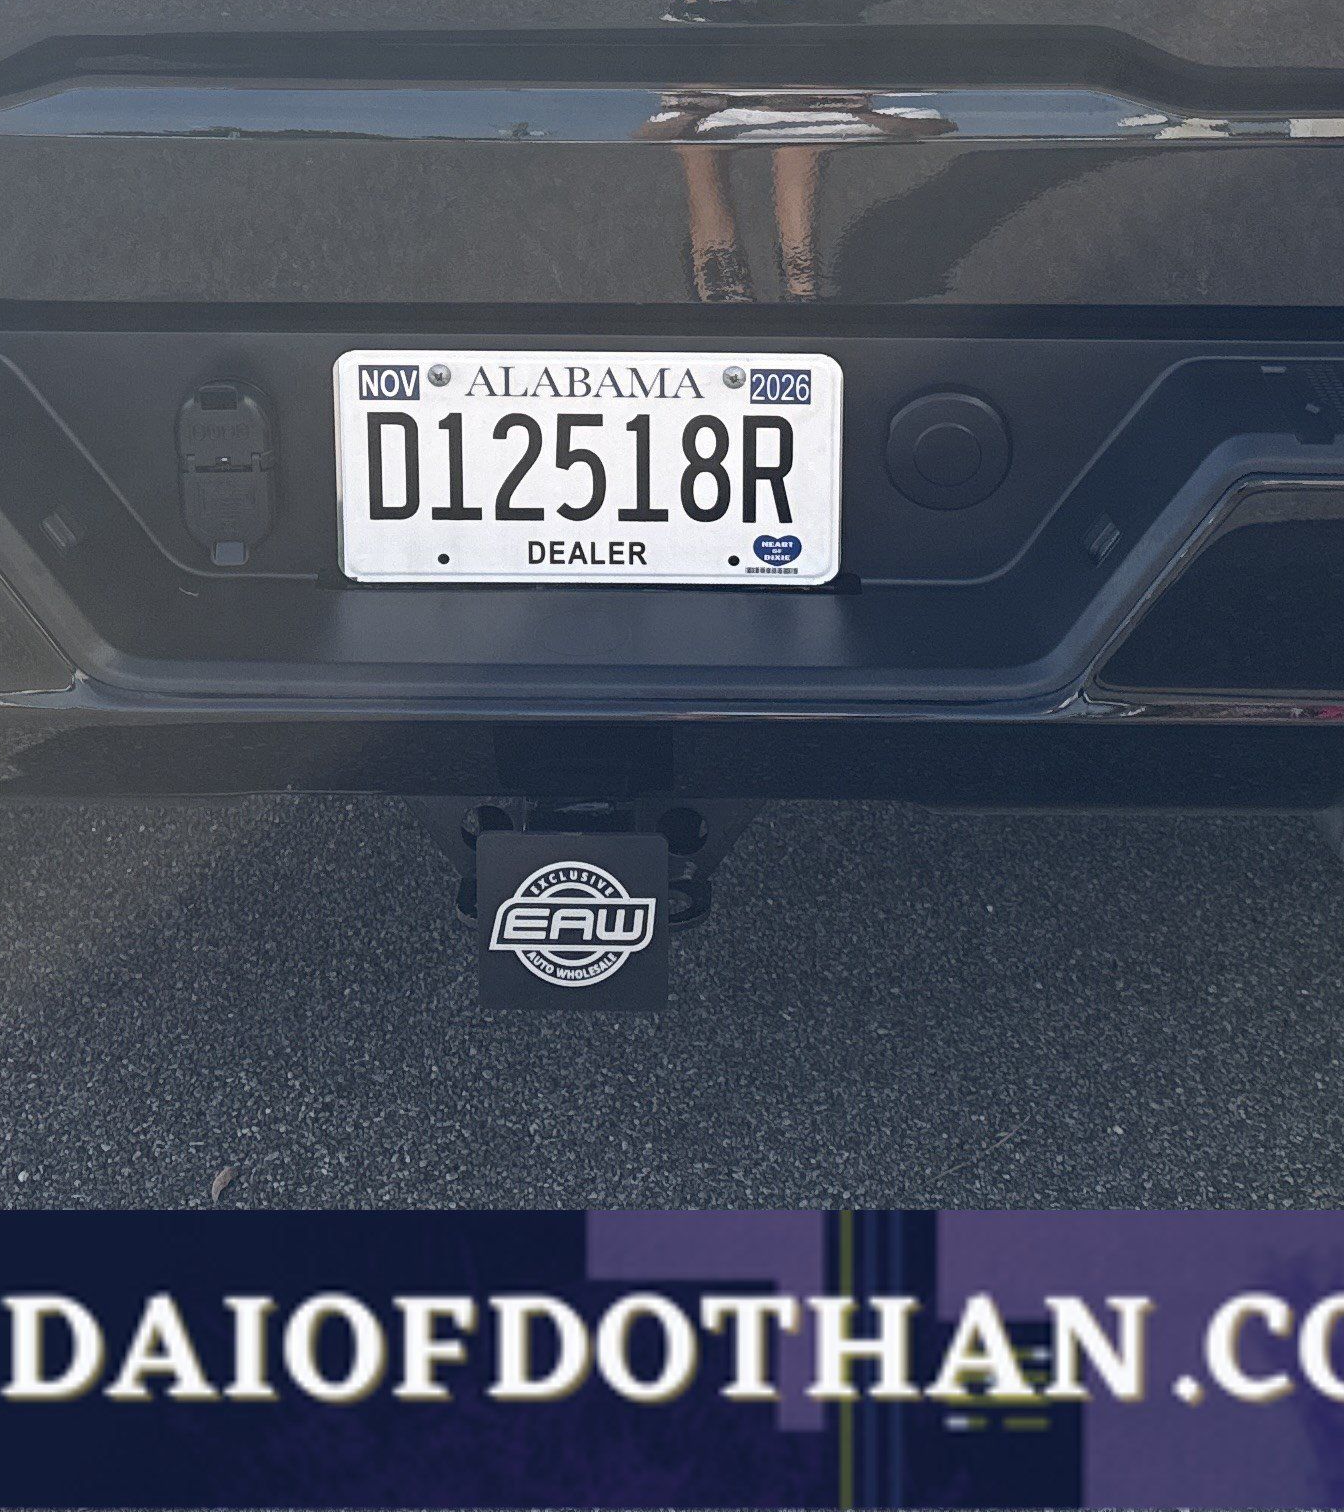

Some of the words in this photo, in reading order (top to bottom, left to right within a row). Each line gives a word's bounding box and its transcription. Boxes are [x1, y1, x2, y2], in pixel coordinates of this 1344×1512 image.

[360, 368, 417, 398] NOV
[464, 365, 705, 400] ALABAMA
[751, 373, 810, 402] 2026
[366, 411, 794, 524] D12518R
[527, 540, 648, 566] DEALER
[529, 869, 616, 898] EXCLUSIVE
[503, 907, 645, 941] EAW
[526, 951, 555, 975] AUTO
[555, 952, 619, 980] WHOLESALE
